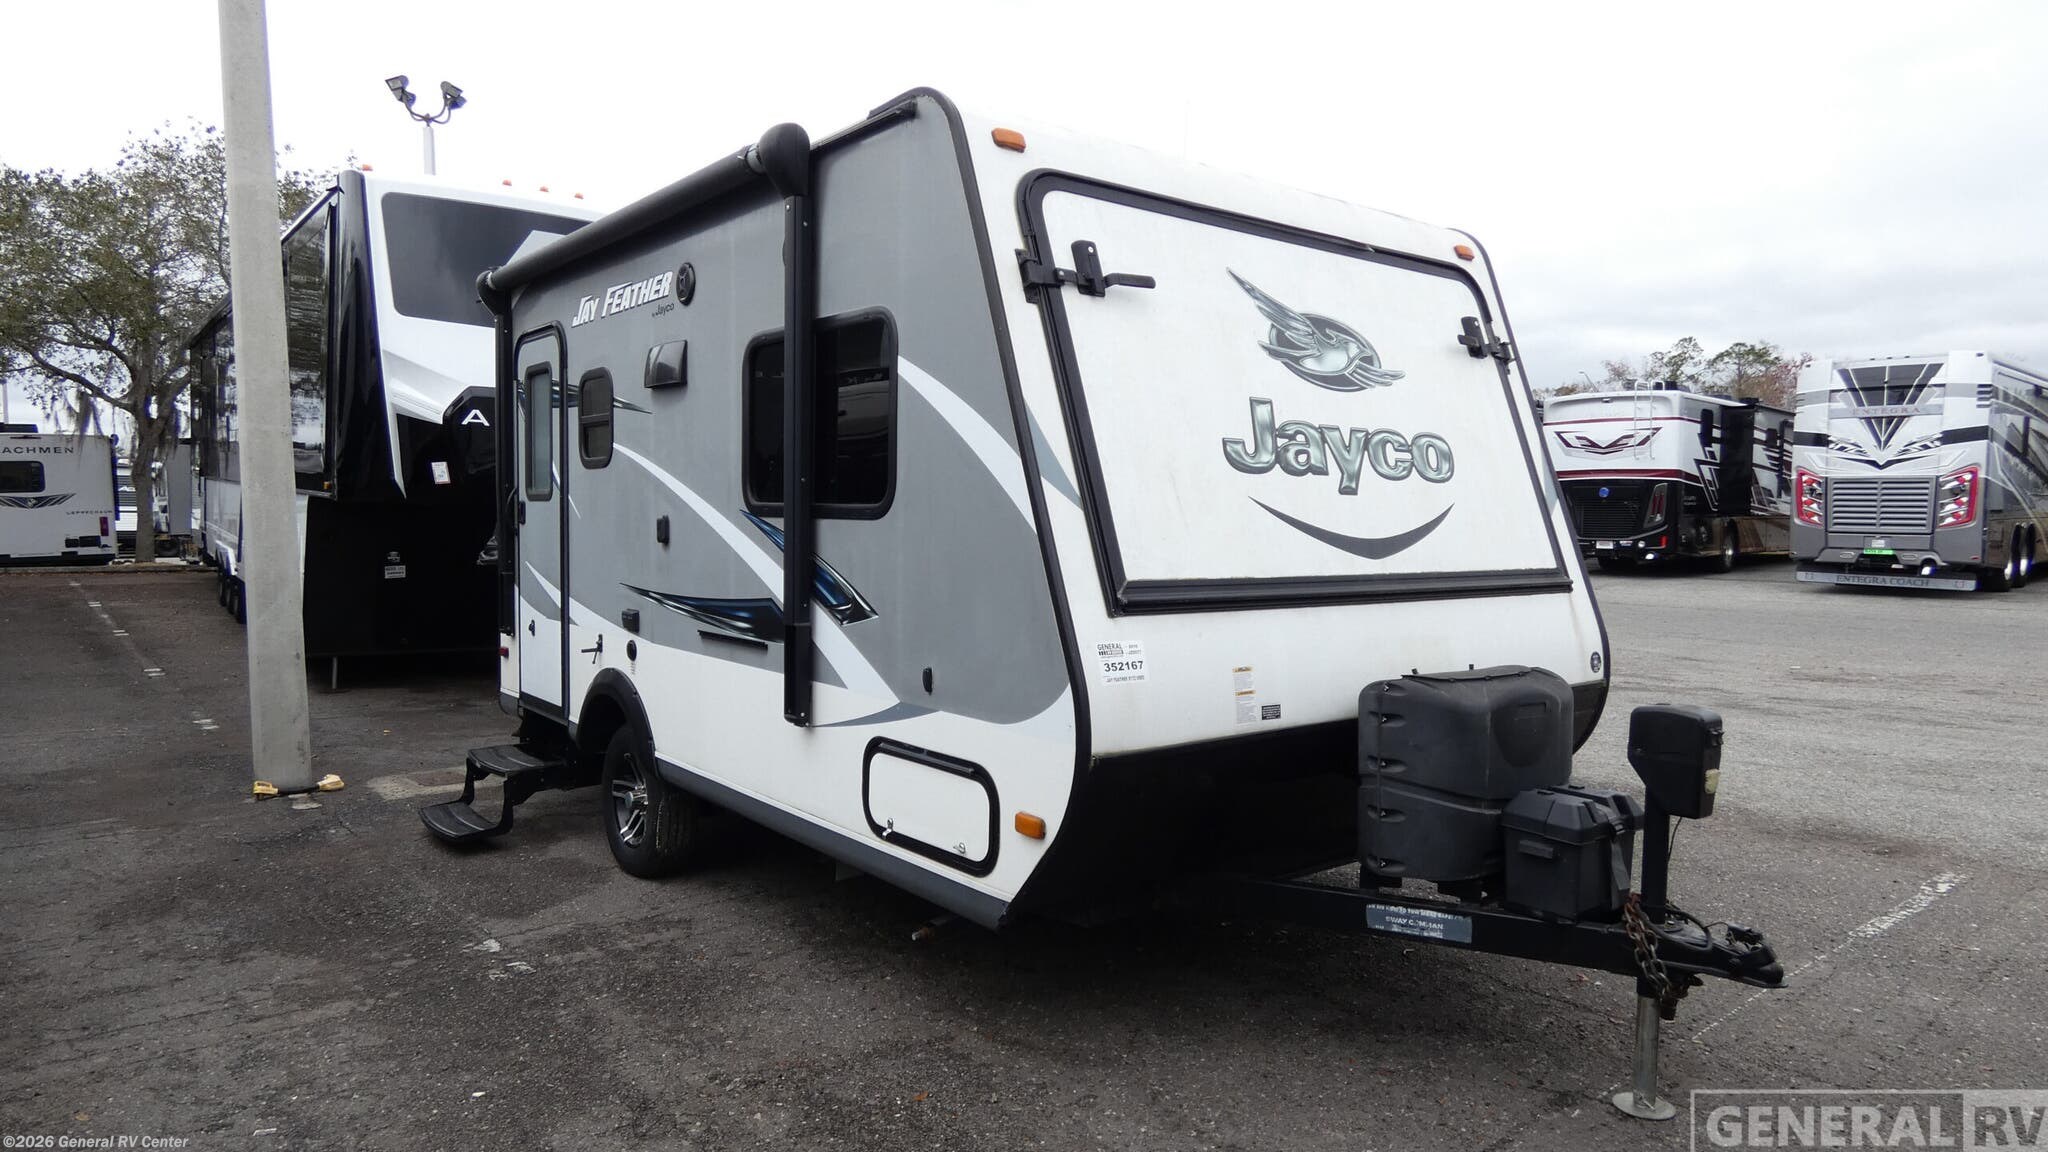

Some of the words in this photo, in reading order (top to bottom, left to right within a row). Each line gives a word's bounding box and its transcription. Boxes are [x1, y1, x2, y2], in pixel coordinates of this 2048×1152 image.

[571, 295, 600, 328] JAY
[601, 271, 673, 319] FEATHER
[1852, 406, 1921, 416] ENTEGRA
[1222, 396, 1455, 496] Jayco
[1836, 574, 1888, 585] ENTEGRA
[1889, 577, 1930, 587] COACH
[1104, 660, 1143, 672] 352167
